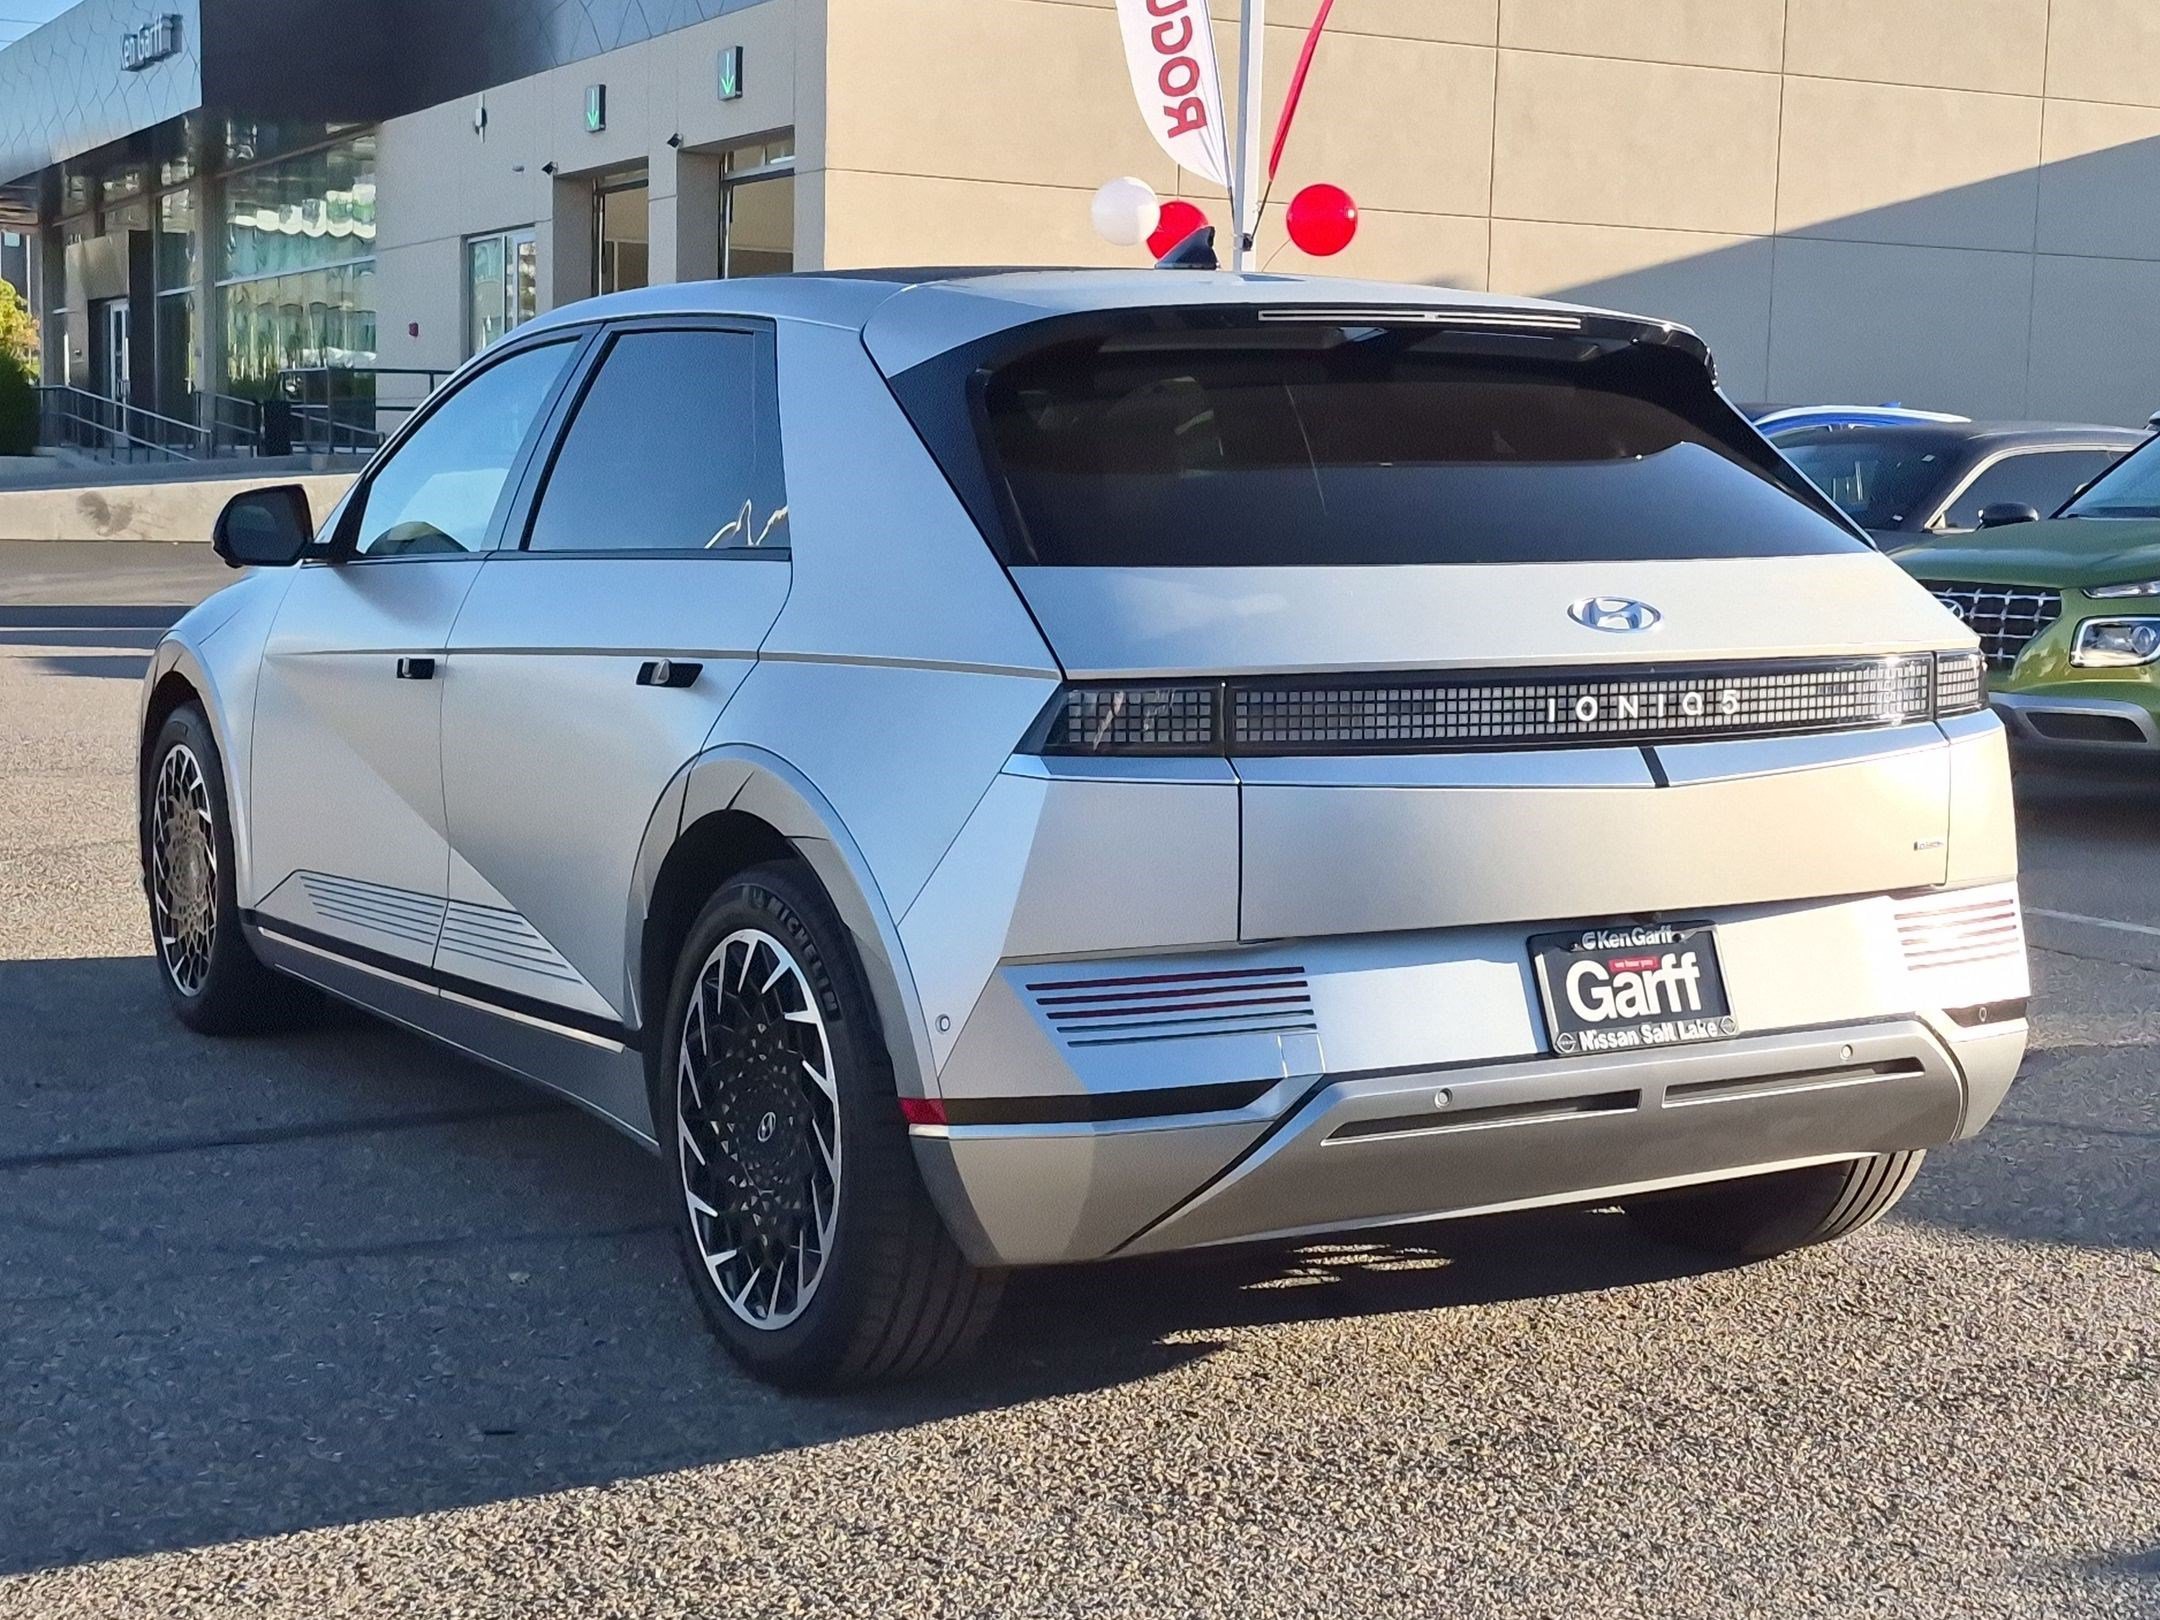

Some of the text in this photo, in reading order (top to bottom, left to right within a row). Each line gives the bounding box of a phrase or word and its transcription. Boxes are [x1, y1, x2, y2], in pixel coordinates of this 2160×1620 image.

[1566, 951, 1702, 1023] Garff
[1579, 1020, 1718, 1051] Nissan Salt Lake
